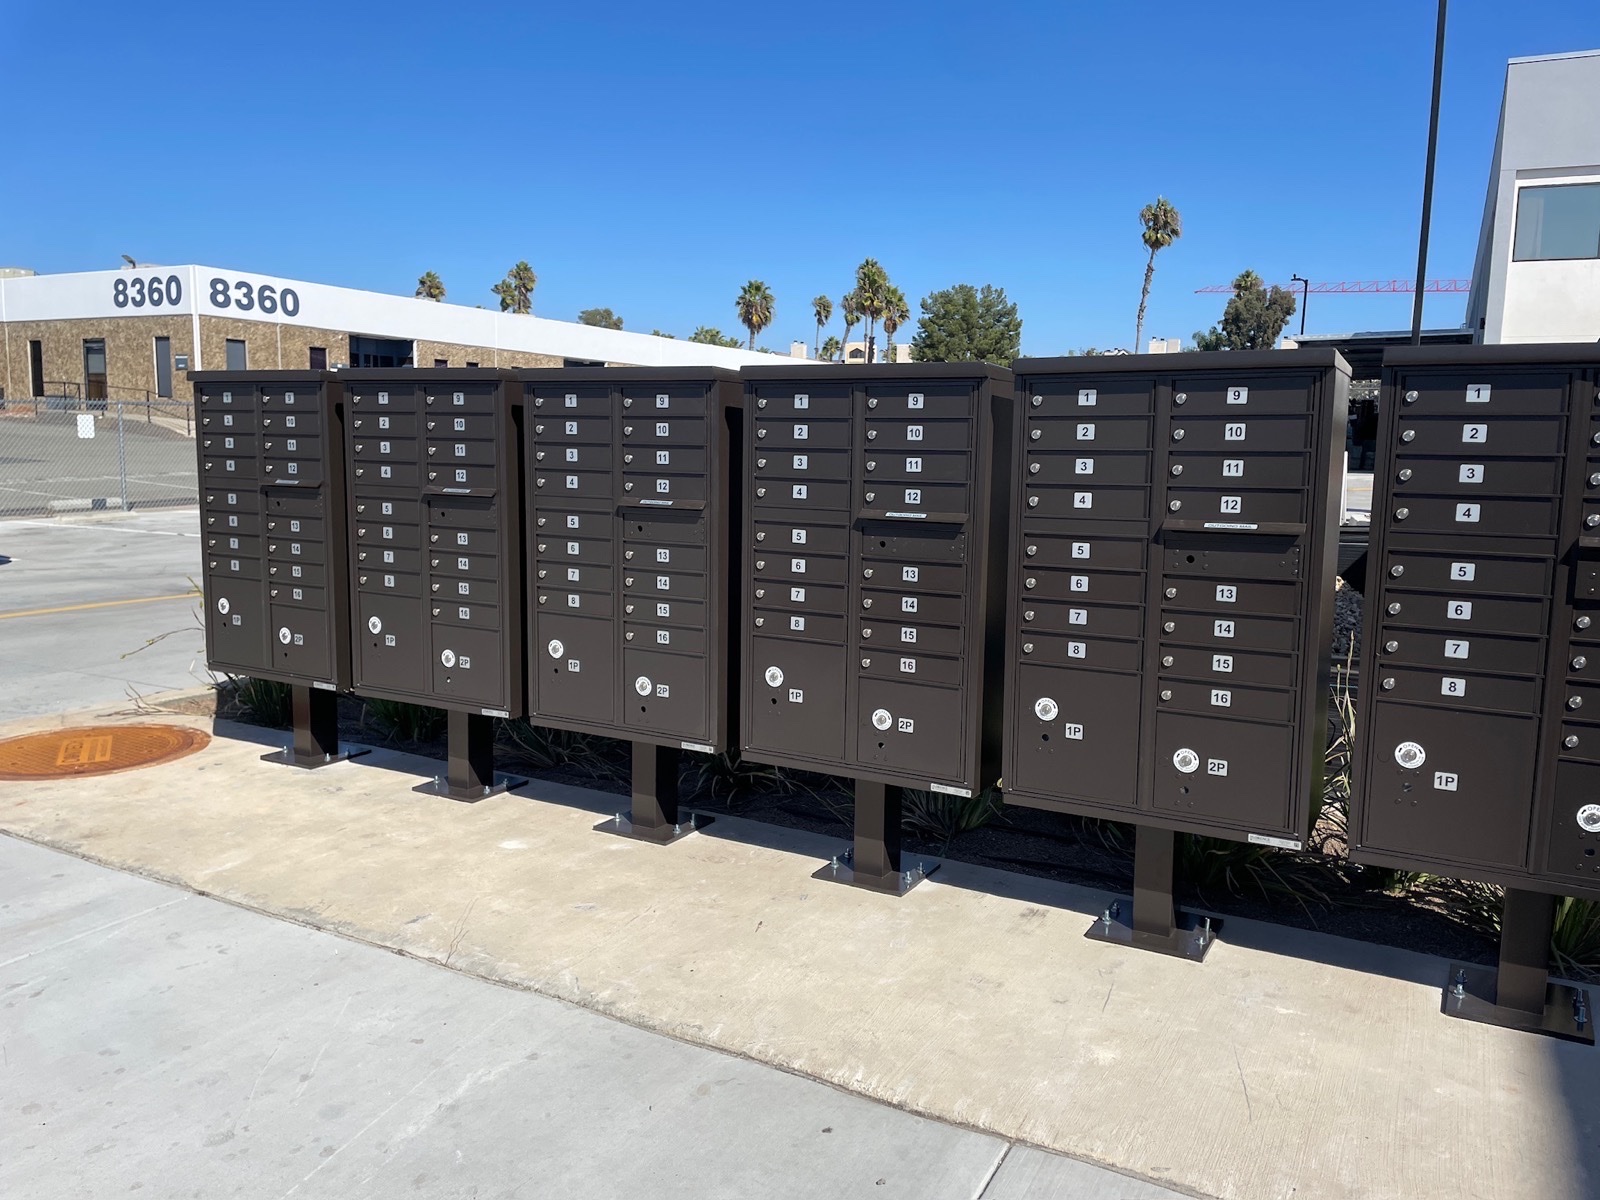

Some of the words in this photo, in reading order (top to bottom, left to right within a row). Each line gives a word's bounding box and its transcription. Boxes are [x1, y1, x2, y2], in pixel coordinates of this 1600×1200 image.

[114, 275, 182, 308] 8360
[210, 278, 300, 317] 8360
[1084, 392, 1089, 402] 1
[1233, 390, 1241, 401] 9
[1474, 387, 1481, 399] 1
[798, 396, 803, 406] 1
[912, 396, 919, 406] 9
[658, 425, 667, 434] 10
[798, 427, 803, 437] 2
[909, 428, 921, 438] 10
[1082, 426, 1089, 437] 2
[1228, 426, 1242, 438] 10
[1469, 427, 1479, 439] 2
[658, 454, 667, 462] 11
[797, 458, 803, 467] 3
[908, 460, 918, 470] 11
[1080, 461, 1087, 471] 3
[1226, 463, 1239, 473] 11
[1466, 468, 1475, 479] 3
[658, 482, 668, 490] 12
[796, 488, 802, 496] 4
[907, 492, 918, 501] 12
[1079, 495, 1086, 505] 4
[1223, 499, 1238, 510] 12
[1462, 507, 1472, 518] 4
[796, 532, 802, 541] 5
[1077, 545, 1084, 555] 5
[658, 551, 668, 560] 13
[795, 561, 801, 570] 6
[904, 569, 916, 579] 13
[1458, 566, 1467, 577] 5
[658, 578, 668, 587] 14
[1076, 578, 1083, 589] 6
[795, 590, 800, 598] 7
[1219, 588, 1233, 599] 13
[904, 600, 915, 609] 14
[658, 606, 668, 615] 15
[1454, 604, 1463, 616] 6
[1074, 612, 1081, 621] 7
[794, 619, 800, 628] 8
[1217, 623, 1231, 634] 14
[658, 633, 668, 642] 16
[903, 630, 914, 640] 15
[1073, 645, 1080, 655] 8
[1452, 643, 1461, 654] 7
[902, 661, 914, 671] 16
[1215, 658, 1230, 669] 15
[657, 686, 668, 695] 2P
[1448, 681, 1457, 693] 8
[790, 691, 802, 700] 1P
[1214, 693, 1228, 704] 16
[899, 720, 912, 730] 2P
[1067, 726, 1081, 736] 1P
[1209, 761, 1225, 772] 2P
[1437, 775, 1455, 787] 1P
